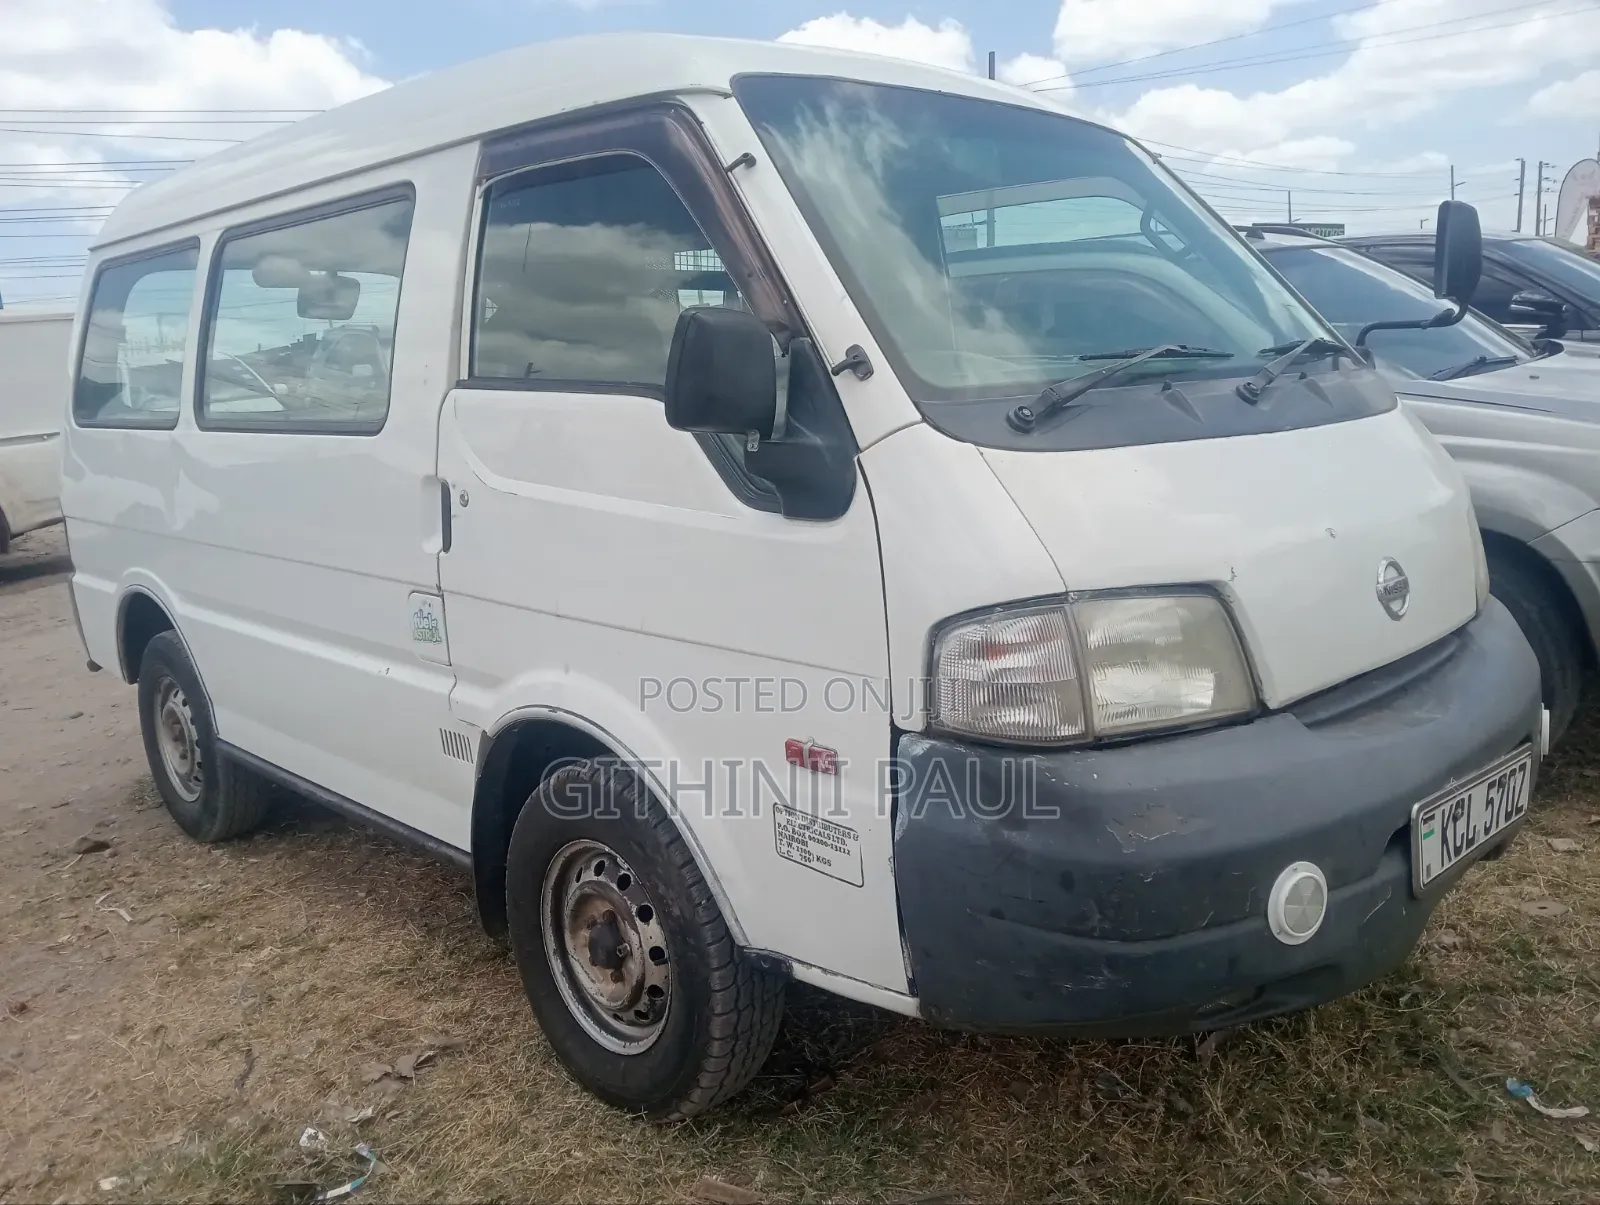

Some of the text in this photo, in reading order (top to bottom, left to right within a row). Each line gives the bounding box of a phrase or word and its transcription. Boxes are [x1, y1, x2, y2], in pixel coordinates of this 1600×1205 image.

[413, 608, 432, 629] fuel
[413, 627, 442, 643] ASTROL
[775, 806, 800, 821] OPTION
[852, 833, 859, 842] &
[1441, 761, 1527, 869] KCL 570Z
[777, 822, 791, 833] P.O.
[791, 828, 807, 839] BOX
[777, 830, 809, 848] NAIROBI
[786, 818, 848, 847] ELECTRICALS LTD.
[778, 838, 785, 846] T.
[816, 855, 832, 867] KGS
